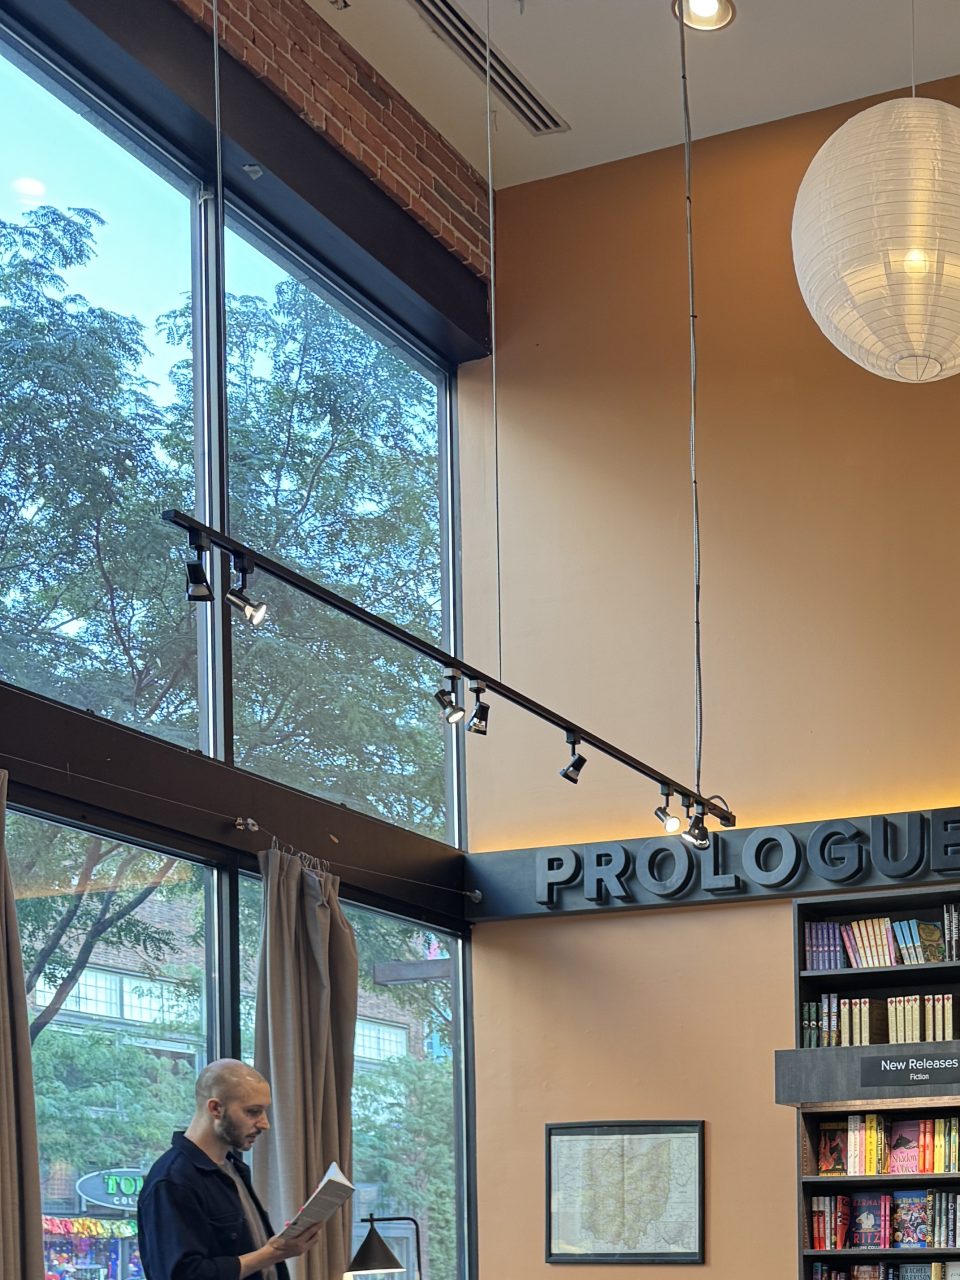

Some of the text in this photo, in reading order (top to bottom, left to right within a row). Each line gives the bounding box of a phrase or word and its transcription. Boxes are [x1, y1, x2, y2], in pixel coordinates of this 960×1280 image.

[881, 1058, 959, 1070] New Releases
[113, 1197, 138, 1205] COL
[853, 1231, 880, 1243] RITZ
